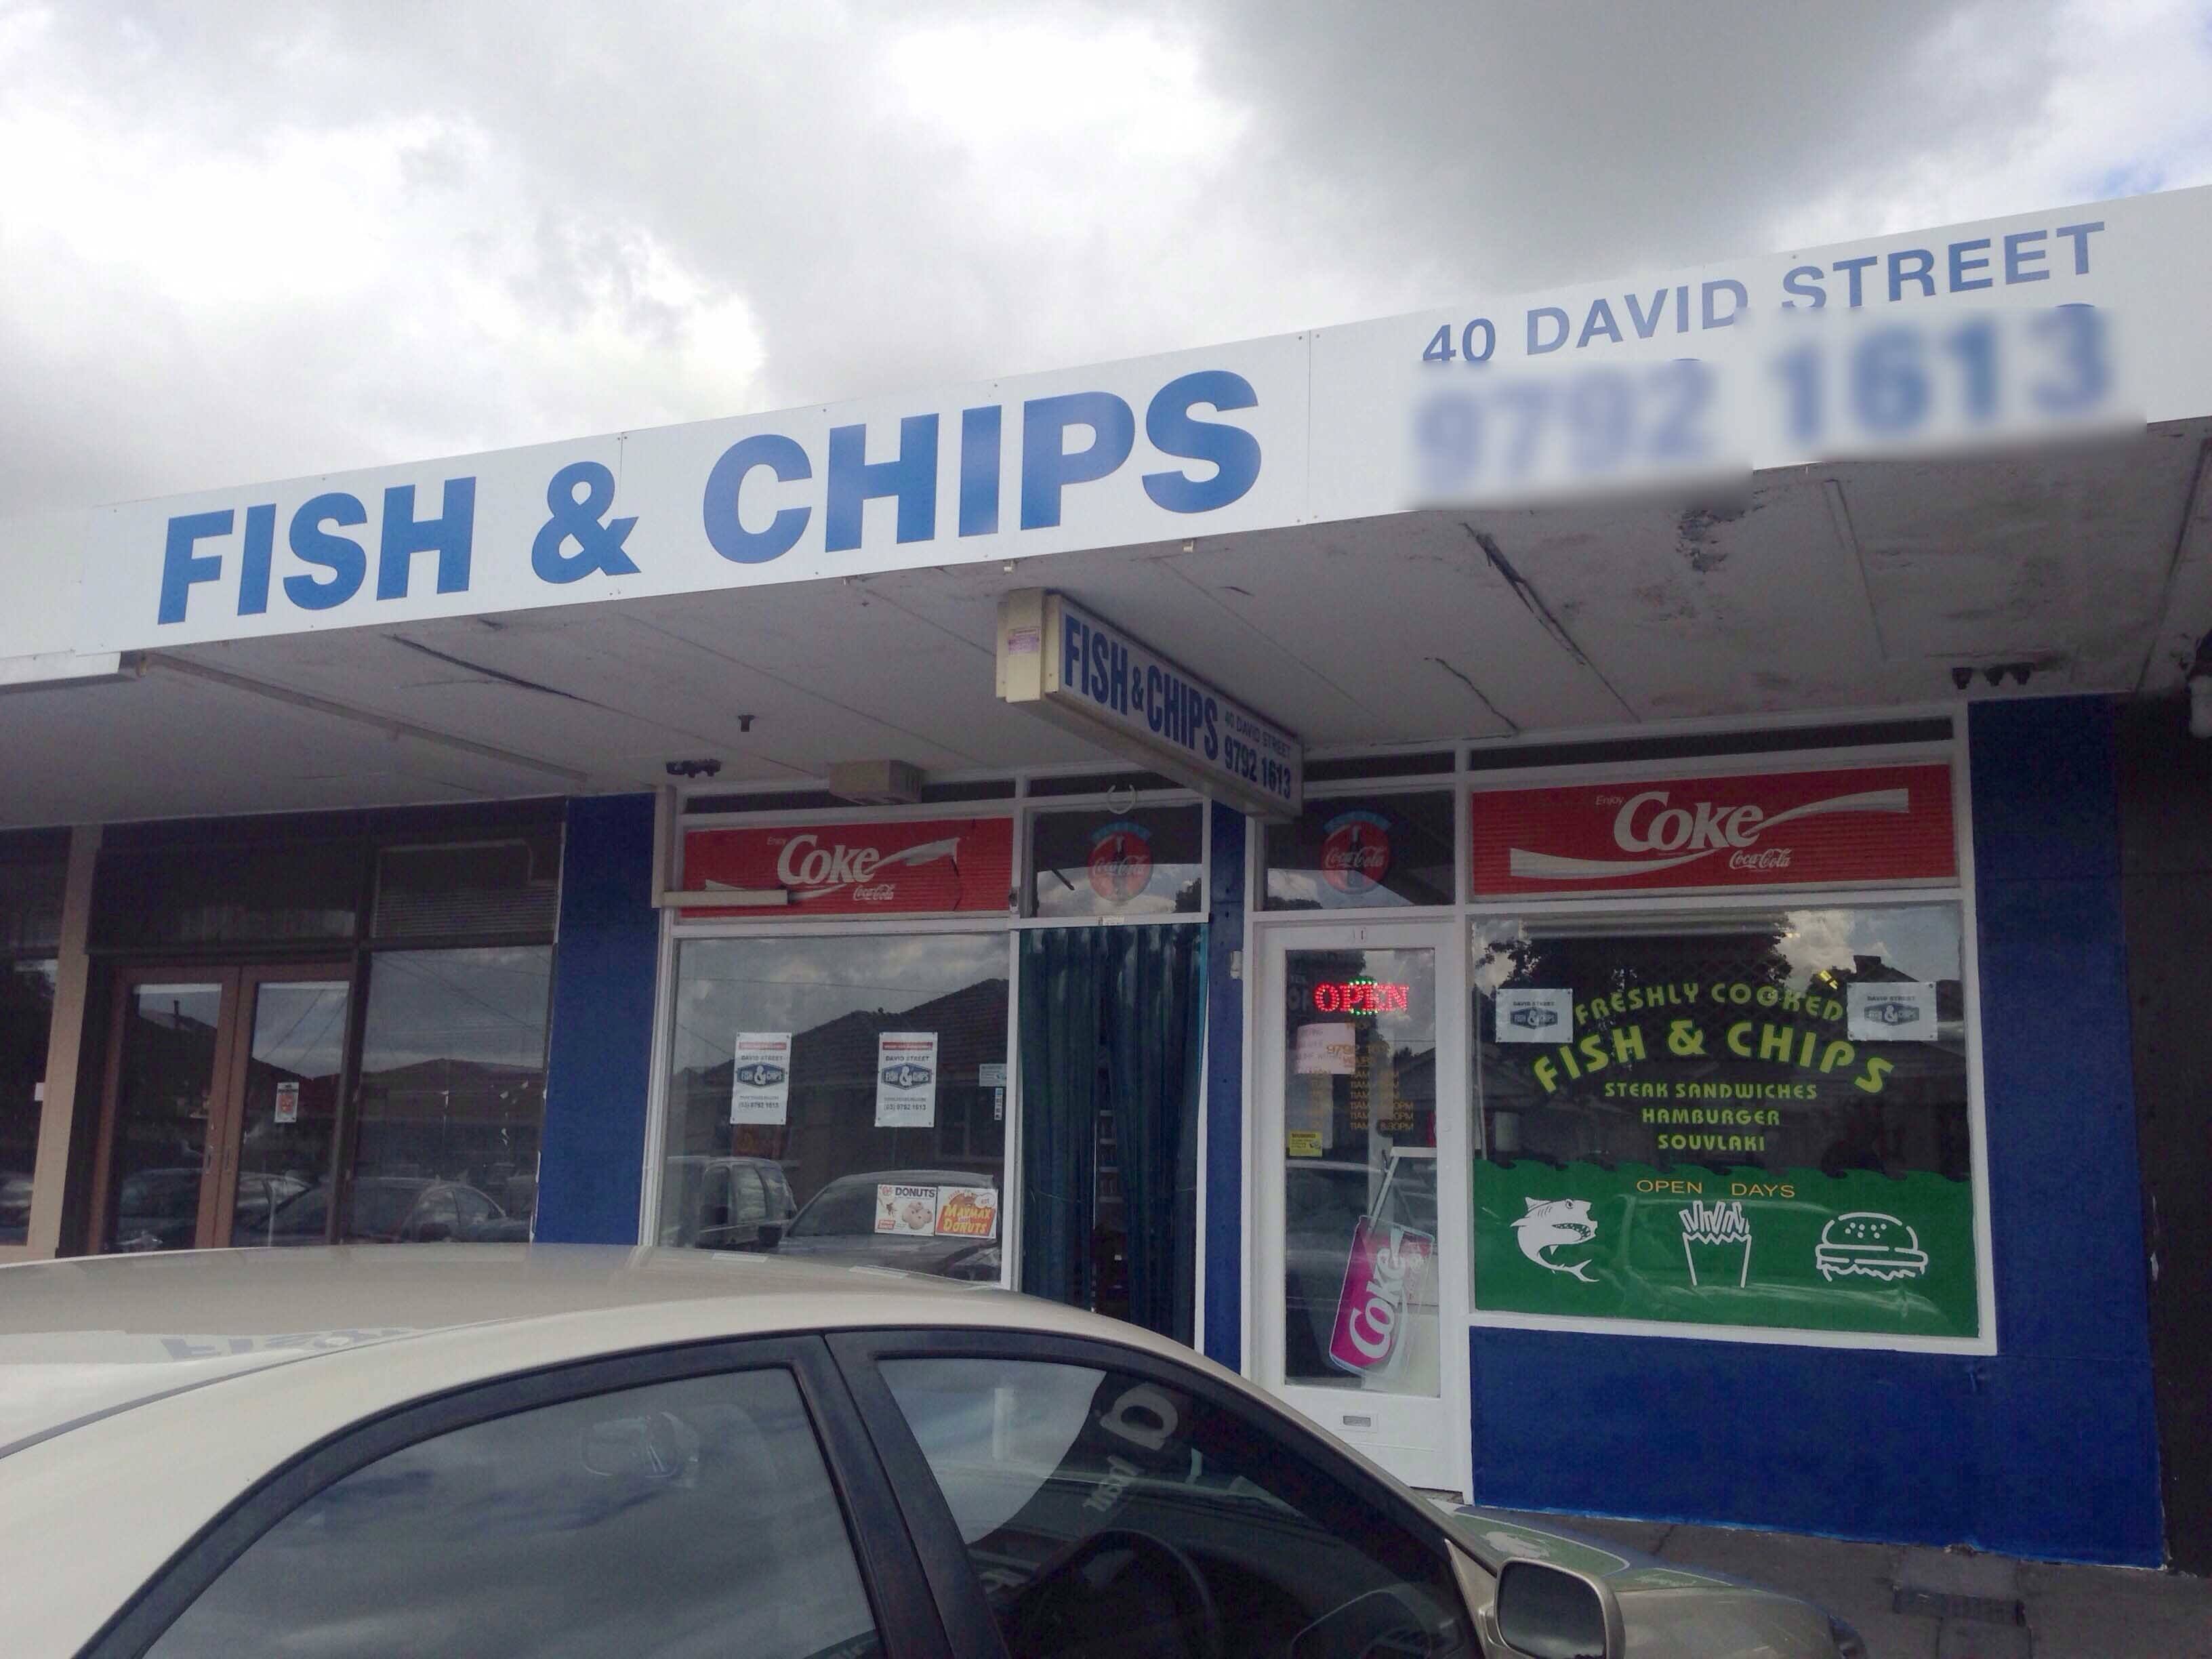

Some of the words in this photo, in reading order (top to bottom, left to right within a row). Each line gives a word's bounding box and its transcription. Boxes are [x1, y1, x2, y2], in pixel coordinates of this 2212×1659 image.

[1423, 317, 1496, 361] 40
[1527, 279, 1748, 356] DAVID
[1782, 221, 2105, 308] STREET
[157, 476, 476, 626] FISH
[531, 461, 642, 584] &
[703, 370, 1262, 565] CHIPS
[1065, 613, 1128, 716] FISH
[1131, 665, 1144, 712] &
[1147, 665, 1218, 760] CHIPS
[1225, 735, 1257, 782] 9792
[1262, 756, 1290, 800] 1613
[1596, 795, 1624, 805] Enjoy
[1614, 792, 1763, 852] Coke
[777, 835, 880, 884] Coke
[1313, 982, 1410, 1012] OPEN
[1576, 983, 1700, 1025] FRESHLY
[1711, 983, 1844, 1022] COOKED
[1533, 1023, 1646, 1093] FISH
[1667, 1021, 1708, 1056] &
[1727, 1021, 1895, 1094] CHIPS
[899, 1066, 912, 1086] &
[1605, 1082, 1668, 1099] STEAK
[1675, 1082, 1818, 1099] SANDWICHES
[1642, 1108, 1781, 1126] HAMBURGER
[1658, 1133, 1765, 1152] SOUVLAKI
[895, 1187, 935, 1198] DONUTS
[1636, 1179, 1703, 1195] OPEN
[1731, 1182, 1796, 1198] DAYS
[942, 1218, 987, 1233] DONUTS
[1349, 1246, 1407, 1359] Coke
